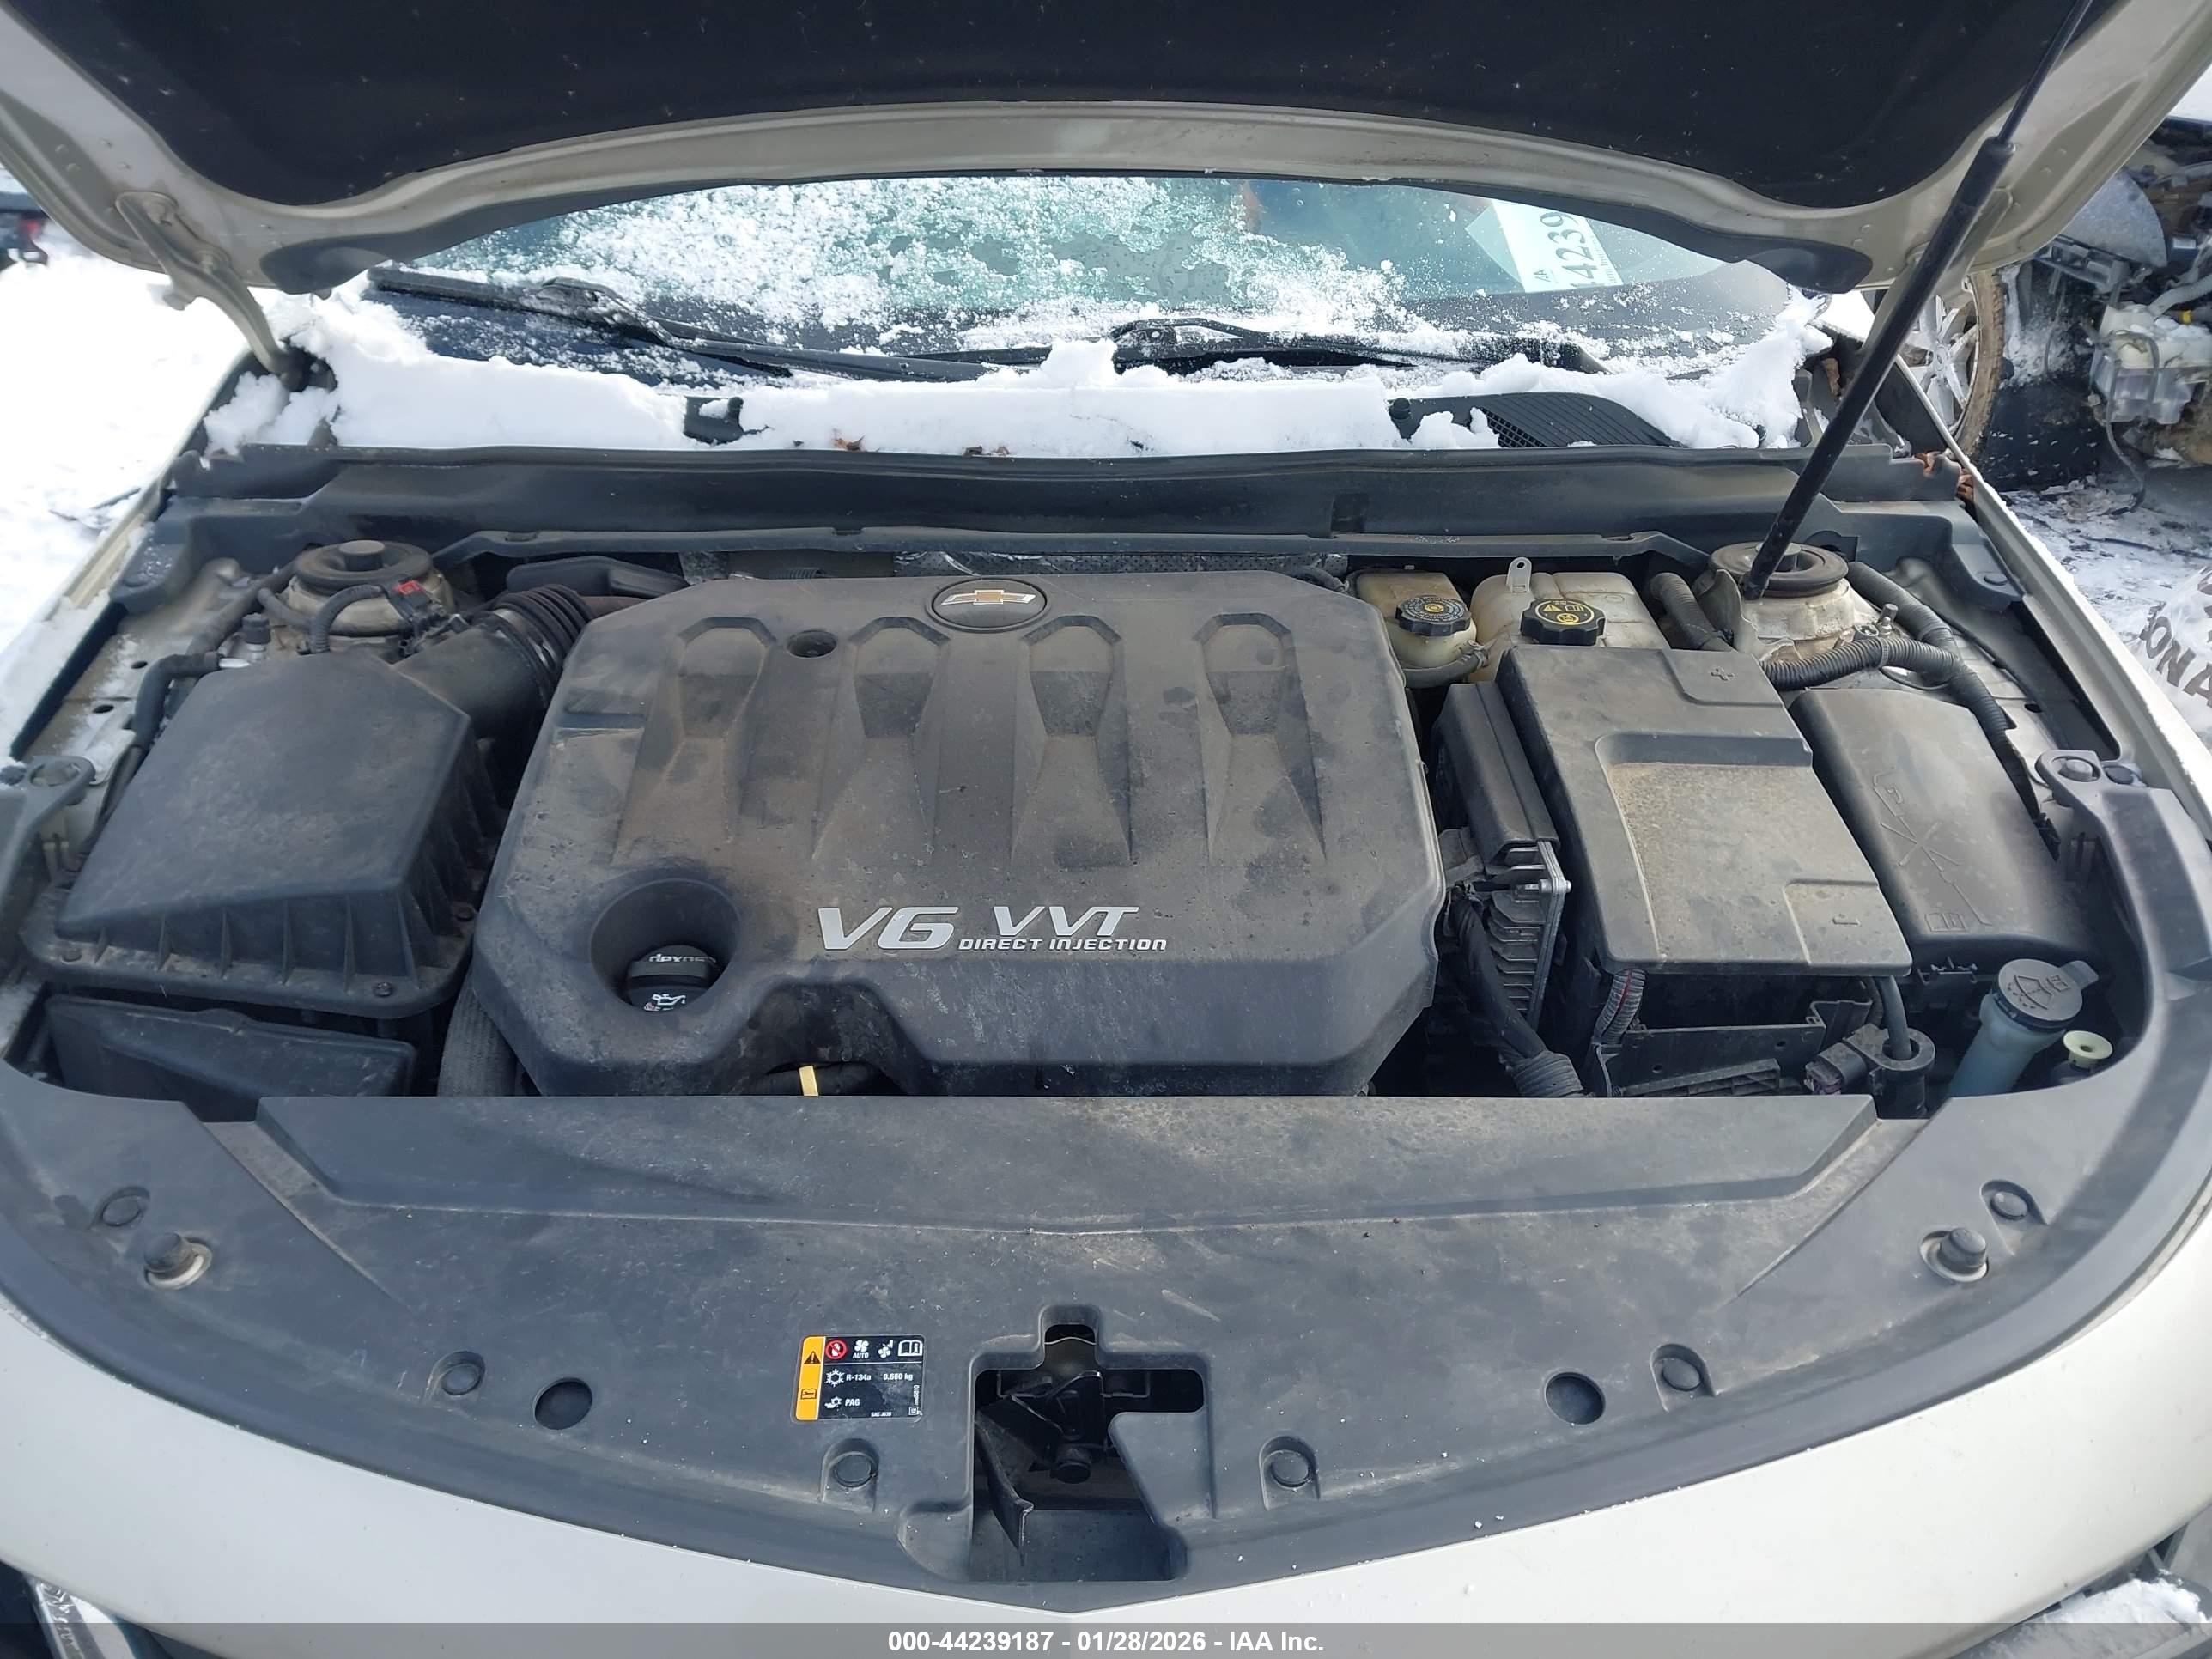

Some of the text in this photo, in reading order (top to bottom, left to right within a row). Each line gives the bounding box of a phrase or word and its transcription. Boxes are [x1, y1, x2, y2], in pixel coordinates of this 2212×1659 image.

[817, 906, 1140, 950] V6 VVT
[957, 938, 1167, 951] DIRECT INJECTION
[846, 1373, 872, 1382] R-134a
[904, 1373, 914, 1382] kg
[844, 1398, 860, 1407] PAG
